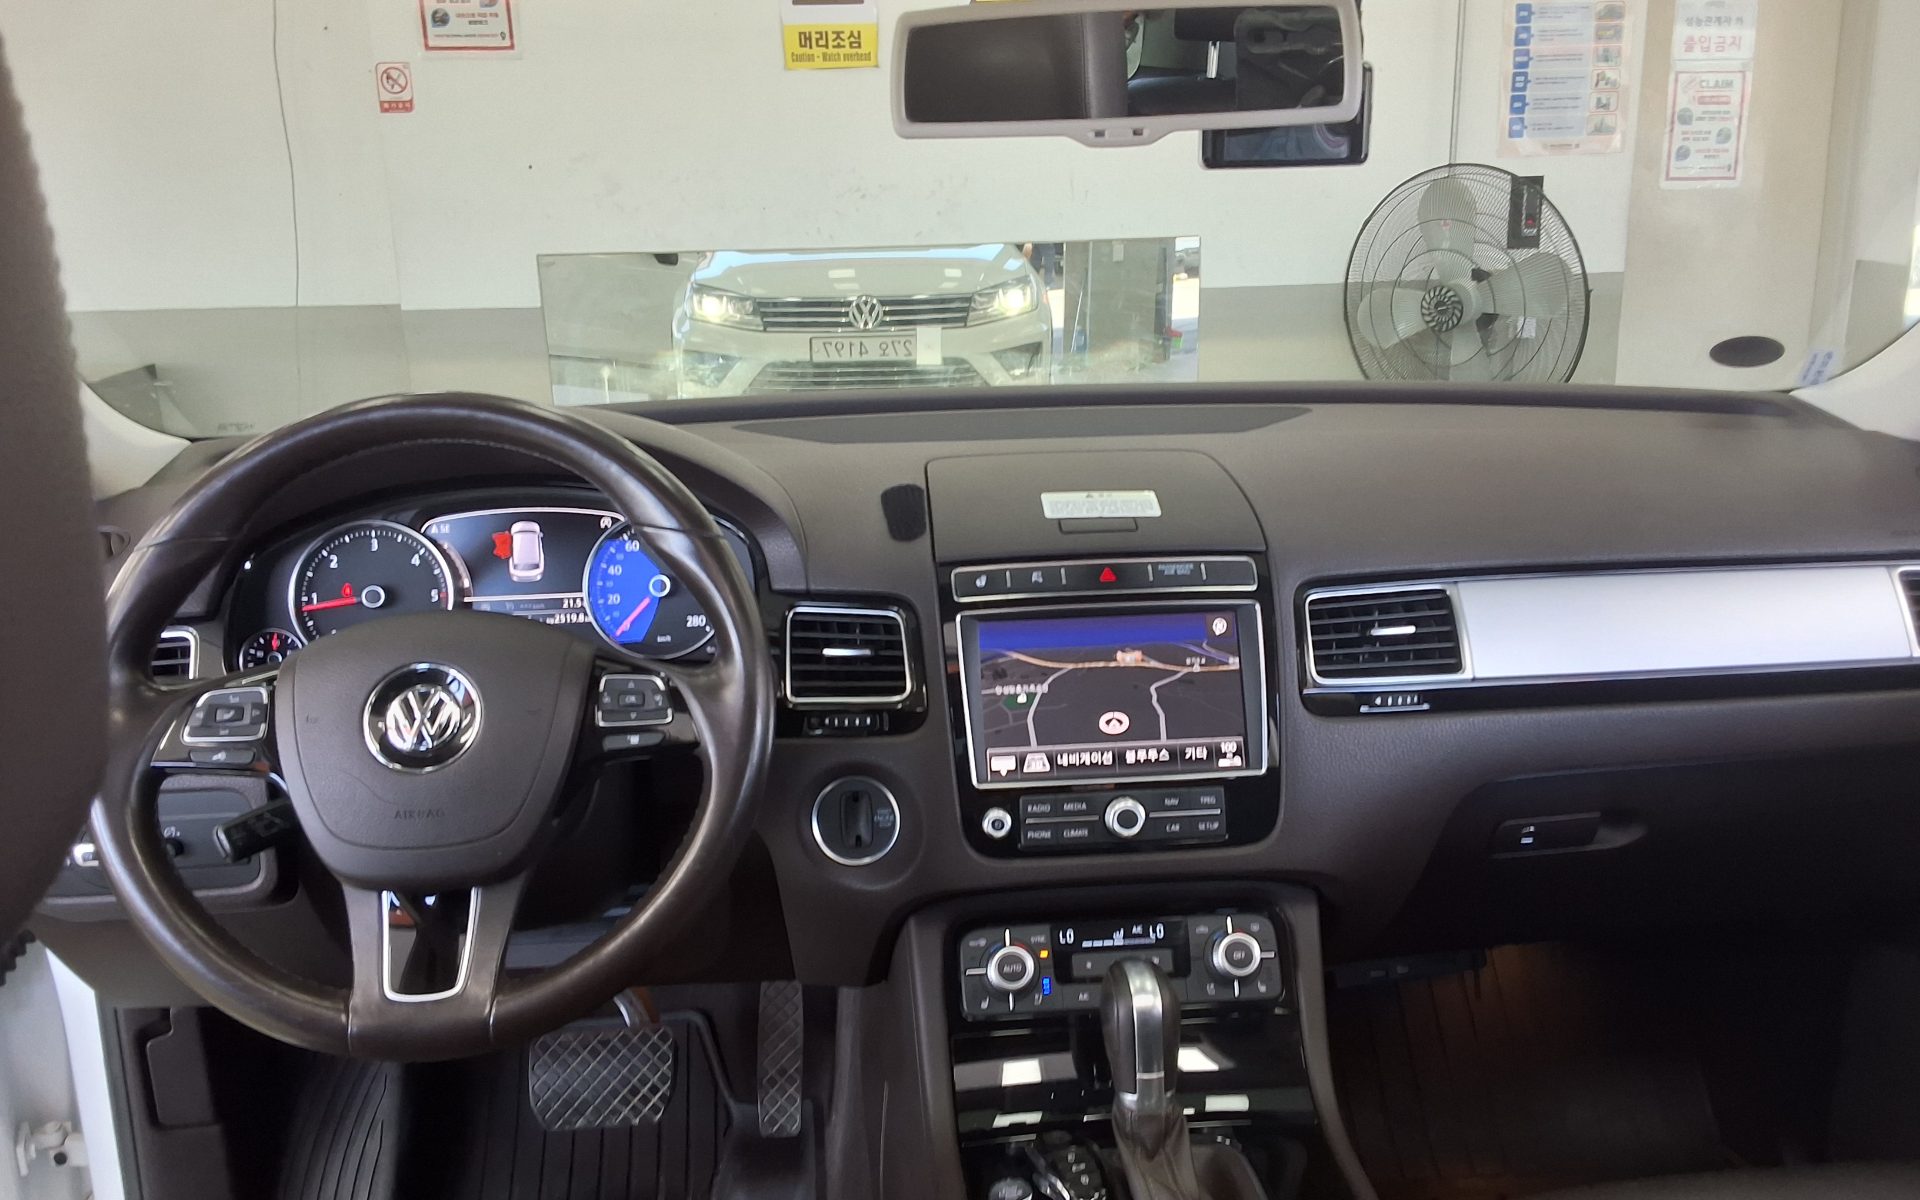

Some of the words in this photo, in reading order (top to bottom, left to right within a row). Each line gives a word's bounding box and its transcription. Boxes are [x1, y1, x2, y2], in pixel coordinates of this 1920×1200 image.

[798, 30, 862, 50] 머리조심
[1683, 35, 1742, 53] 출입금지
[791, 51, 815, 63] Caution
[822, 51, 841, 63] Watch
[843, 51, 872, 62] overhead
[1699, 79, 1734, 89] CLAIM
[371, 538, 378, 552] 3
[625, 540, 639, 552] 60
[329, 554, 338, 569] 2
[411, 553, 420, 567] 4
[607, 564, 622, 576] 40
[607, 593, 620, 605] 20
[686, 614, 706, 627] 280
[1220, 741, 1238, 753] 100
[1056, 747, 1113, 767] 내비게이션
[1184, 746, 1208, 761] 기타
[1063, 802, 1087, 811] MEDIA
[1164, 797, 1180, 806] NAV
[394, 808, 446, 820] AIRBAG
[1027, 803, 1050, 813] RADIO
[1166, 823, 1180, 833] CAR
[1198, 822, 1220, 831] SETUP
[1027, 830, 1052, 840] PHONE
[1003, 963, 1023, 974] AUTO
